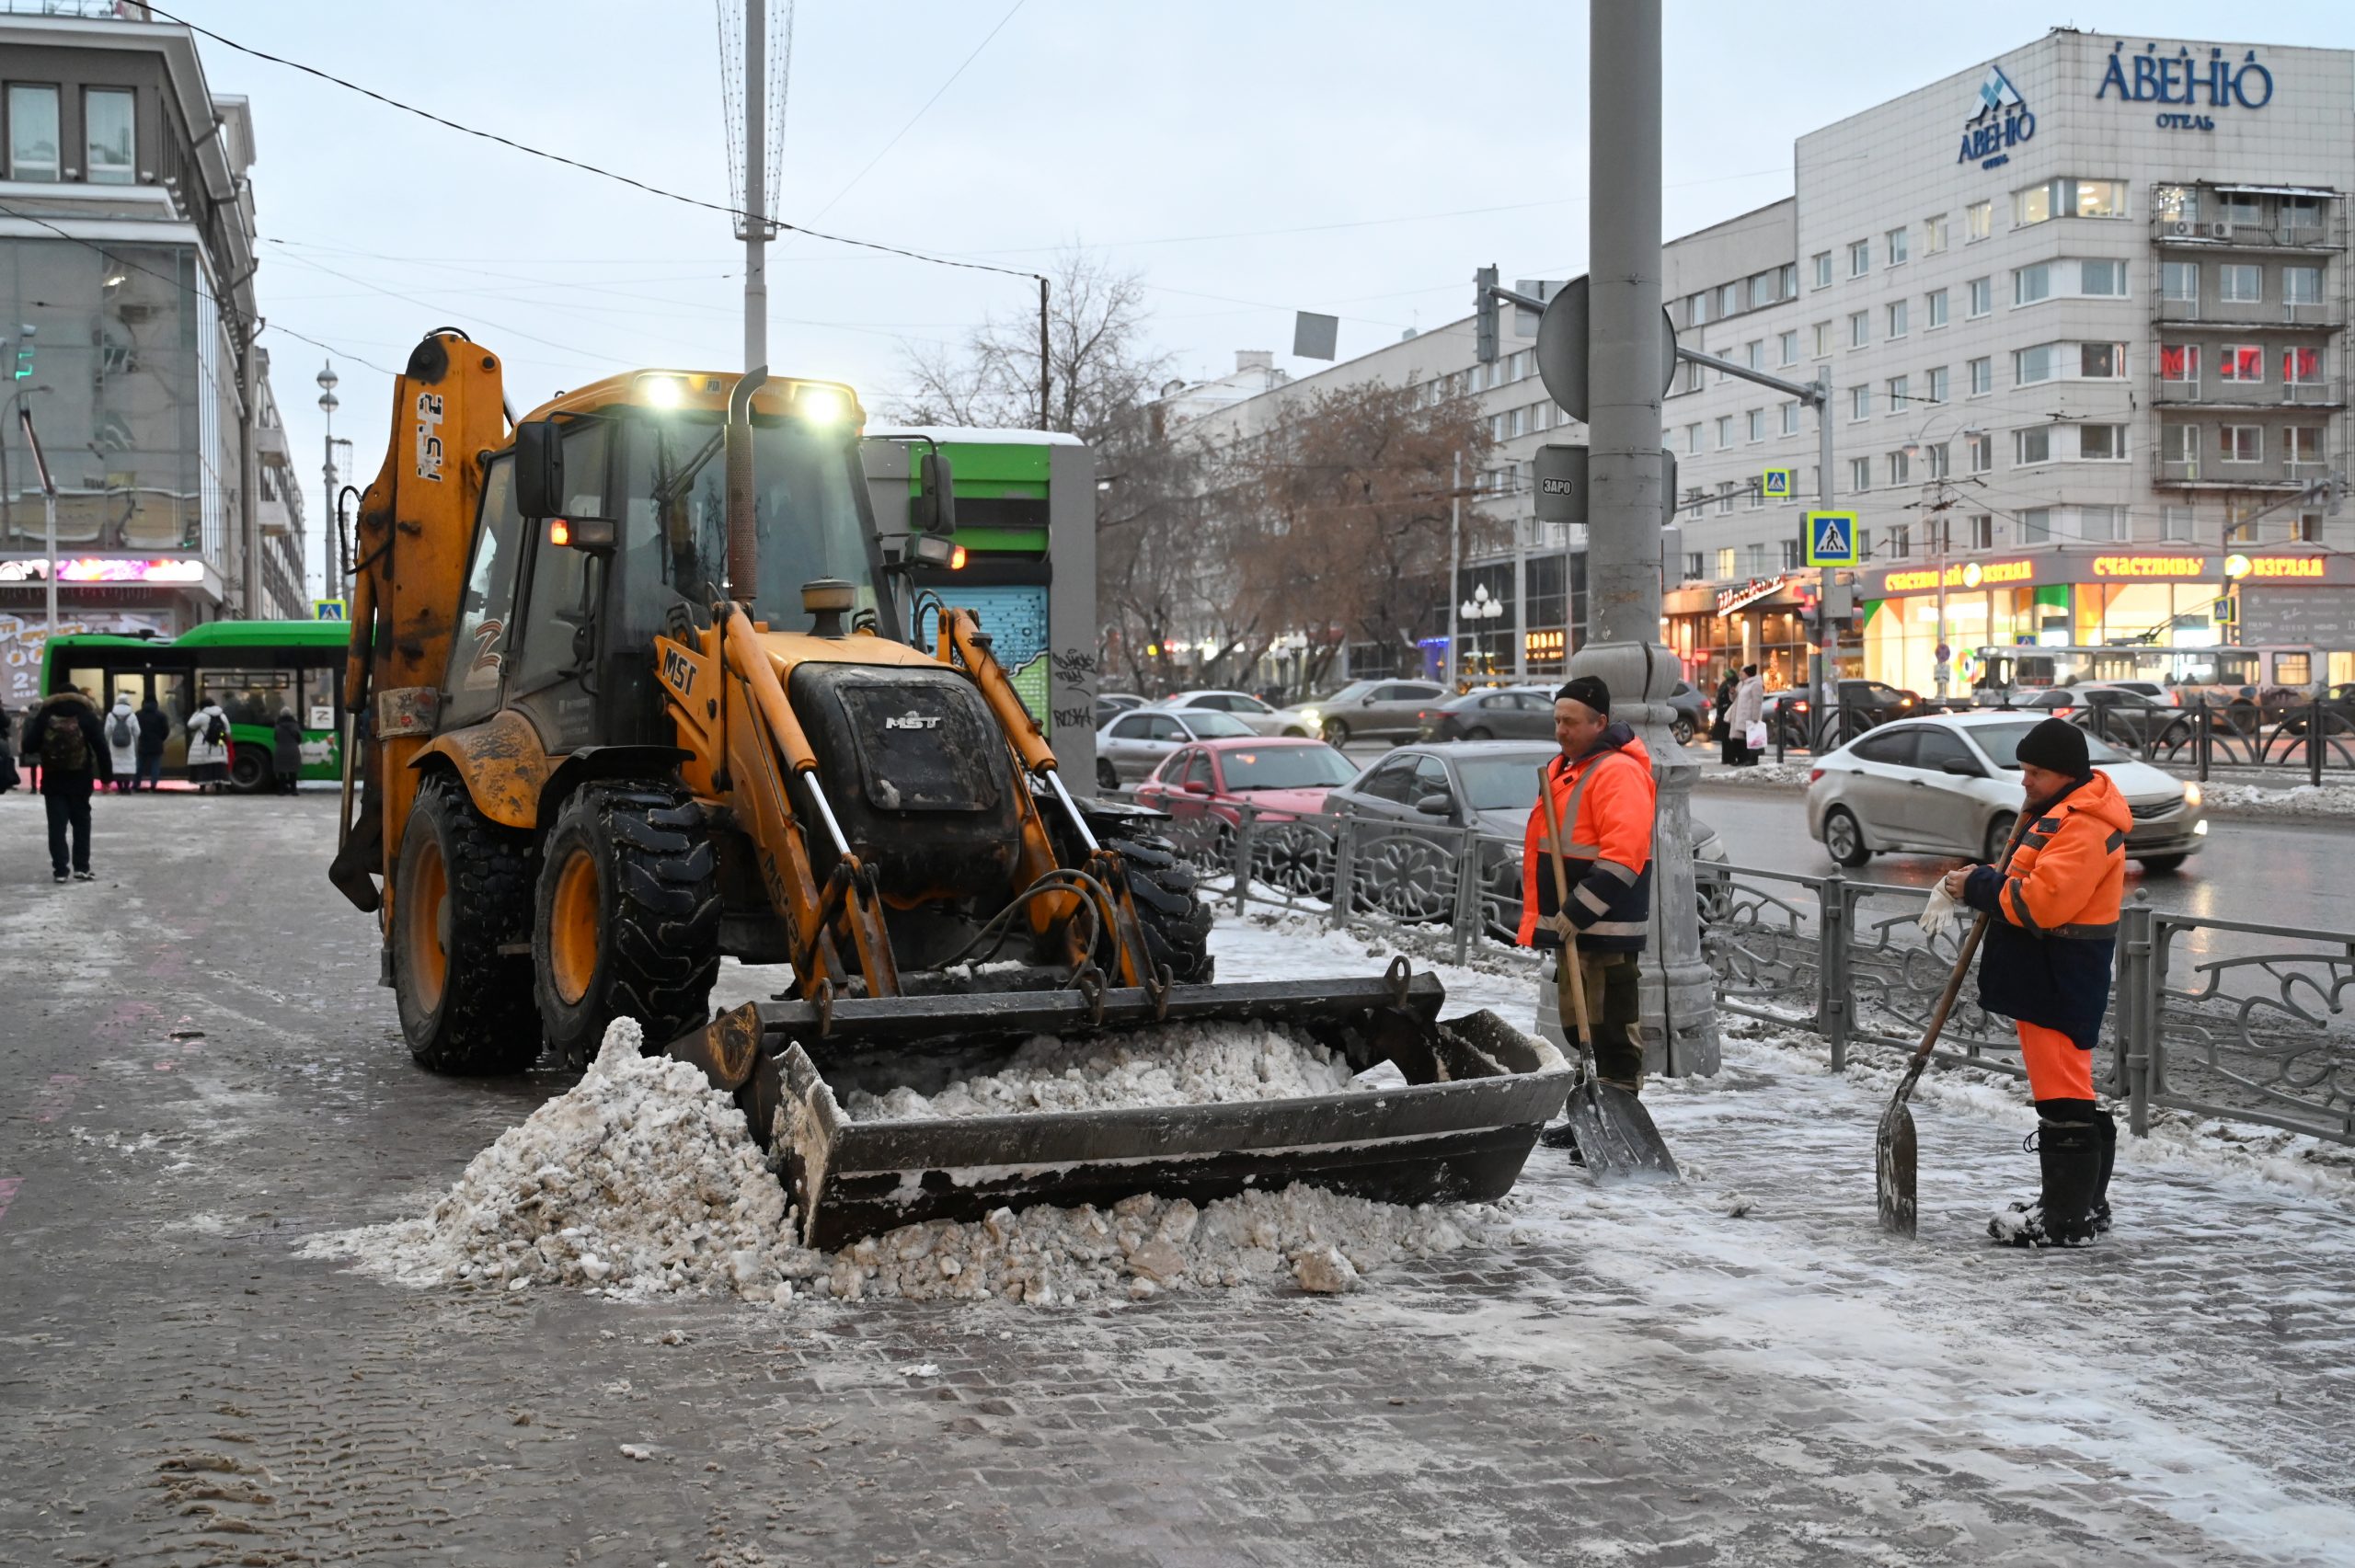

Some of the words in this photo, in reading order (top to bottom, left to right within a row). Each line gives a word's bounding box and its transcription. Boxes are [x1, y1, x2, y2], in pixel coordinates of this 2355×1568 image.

[2095, 41, 2274, 109] АВЕНЮ
[1957, 103, 2036, 165] АВЕНЮ
[2155, 113, 2215, 131] ОТЕЛЬ
[662, 646, 697, 697] MST
[886, 716, 942, 729] MST
